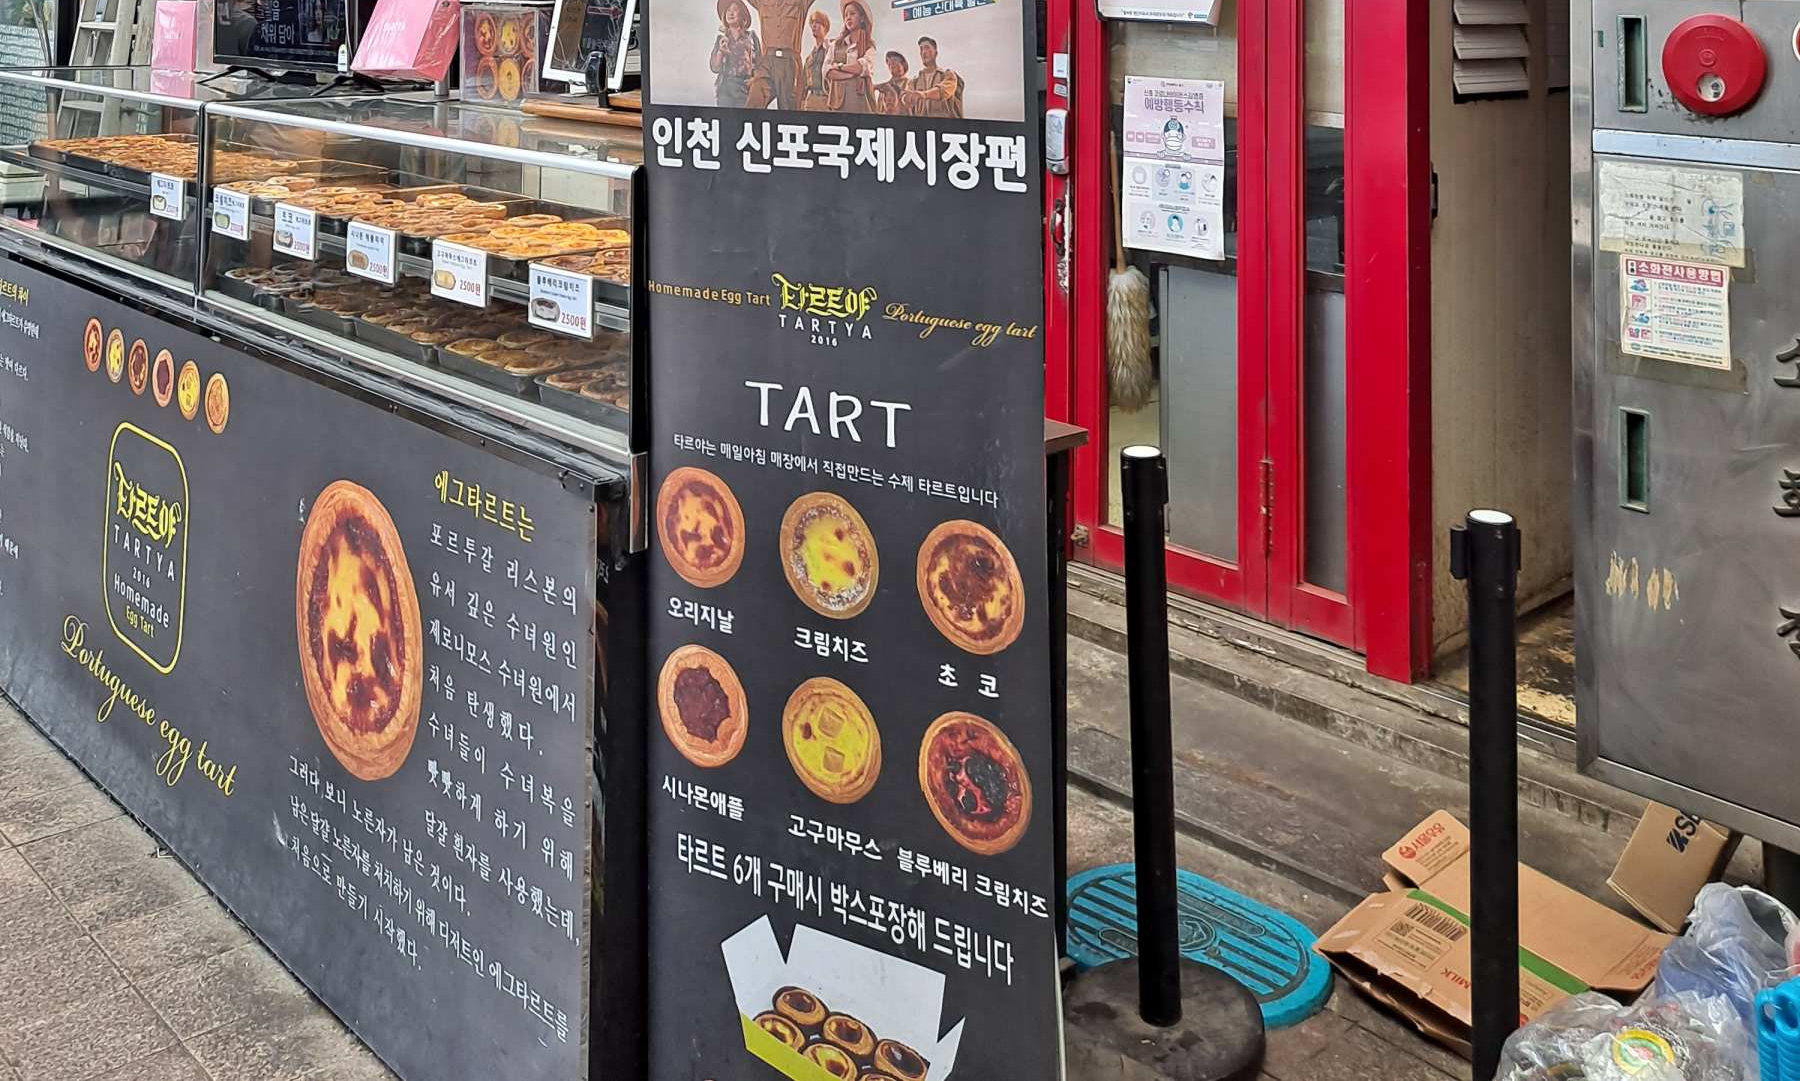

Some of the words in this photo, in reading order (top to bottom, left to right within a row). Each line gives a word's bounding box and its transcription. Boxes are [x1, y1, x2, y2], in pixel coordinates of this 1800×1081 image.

[1144, 97, 1205, 115] 예방행동수칙
[651, 117, 721, 170] 인천
[736, 121, 1028, 194] 신포국제시장편
[561, 312, 587, 331] 2500원
[648, 280, 719, 301] Homemade
[720, 286, 742, 305] Egg
[746, 291, 771, 307] Tart
[778, 314, 873, 340] TARTYA
[882, 302, 972, 340] Portuguese
[974, 323, 1003, 348] egg
[1005, 321, 1038, 339] tart
[811, 334, 838, 347] 2016
[744, 380, 913, 448] TART
[434, 470, 535, 542] 에그타르트는
[720, 442, 767, 466] 매일아침
[770, 451, 818, 475] 매장에서
[822, 460, 885, 487] 직접만드는
[887, 473, 914, 493] 수제
[918, 478, 999, 509] 타르트입니다
[113, 524, 176, 583] TARTYA
[132, 565, 151, 589] 2016
[430, 523, 494, 573] 포르투갈
[506, 559, 577, 615] 리스본의
[113, 572, 171, 630] Homemade
[125, 606, 140, 630] Egg
[141, 613, 155, 639] Tart
[429, 572, 456, 607] 유서
[466, 592, 496, 628] 깊은
[506, 613, 578, 669] 수녀원인
[667, 597, 735, 635] 오리지날
[428, 620, 492, 675] 제로니모스
[498, 660, 576, 723] 수녀원에서
[793, 626, 869, 663] 크림치즈
[60, 614, 156, 724] Portuguese
[160, 722, 193, 788] egg
[196, 737, 239, 798] tart
[428, 664, 456, 700] 처음
[466, 690, 544, 756] 탄생했다.
[938, 663, 958, 687] 초
[978, 674, 1000, 699] 코
[427, 713, 487, 774] 수녀들이
[500, 762, 575, 828] 수녀복을
[662, 775, 745, 822] 시나몬애플
[288, 755, 320, 793] 그러다
[324, 780, 347, 814] 보니
[352, 800, 399, 852] 노른자가
[402, 838, 424, 877] 남은
[429, 863, 472, 918] 것이다.
[426, 759, 482, 822] 빳빳하게
[493, 809, 527, 850] 하기
[541, 837, 573, 882] 위해
[787, 814, 883, 862] 고구마무스
[289, 835, 333, 887] 처음으로
[336, 874, 369, 920] 만들기
[373, 905, 423, 971] 시작했다.
[424, 810, 448, 848] 달걀
[452, 832, 492, 882] 흰자를
[497, 868, 581, 947] 사용했는데,
[677, 832, 728, 880] 타르트
[733, 853, 762, 898] 6개
[767, 863, 823, 917] 구매시
[829, 886, 926, 952] 박스포장해
[933, 916, 1015, 986] 드립니다
[896, 847, 968, 892] 블루베리
[974, 873, 1049, 919] 크림치즈
[289, 795, 310, 827] 남은
[310, 811, 330, 844] 달걀
[332, 827, 371, 877] 노른자를
[373, 860, 413, 914] 처치하기
[415, 897, 436, 936] 위해
[439, 920, 485, 978] 디저트인
[488, 961, 570, 1043] 에그타르트를
